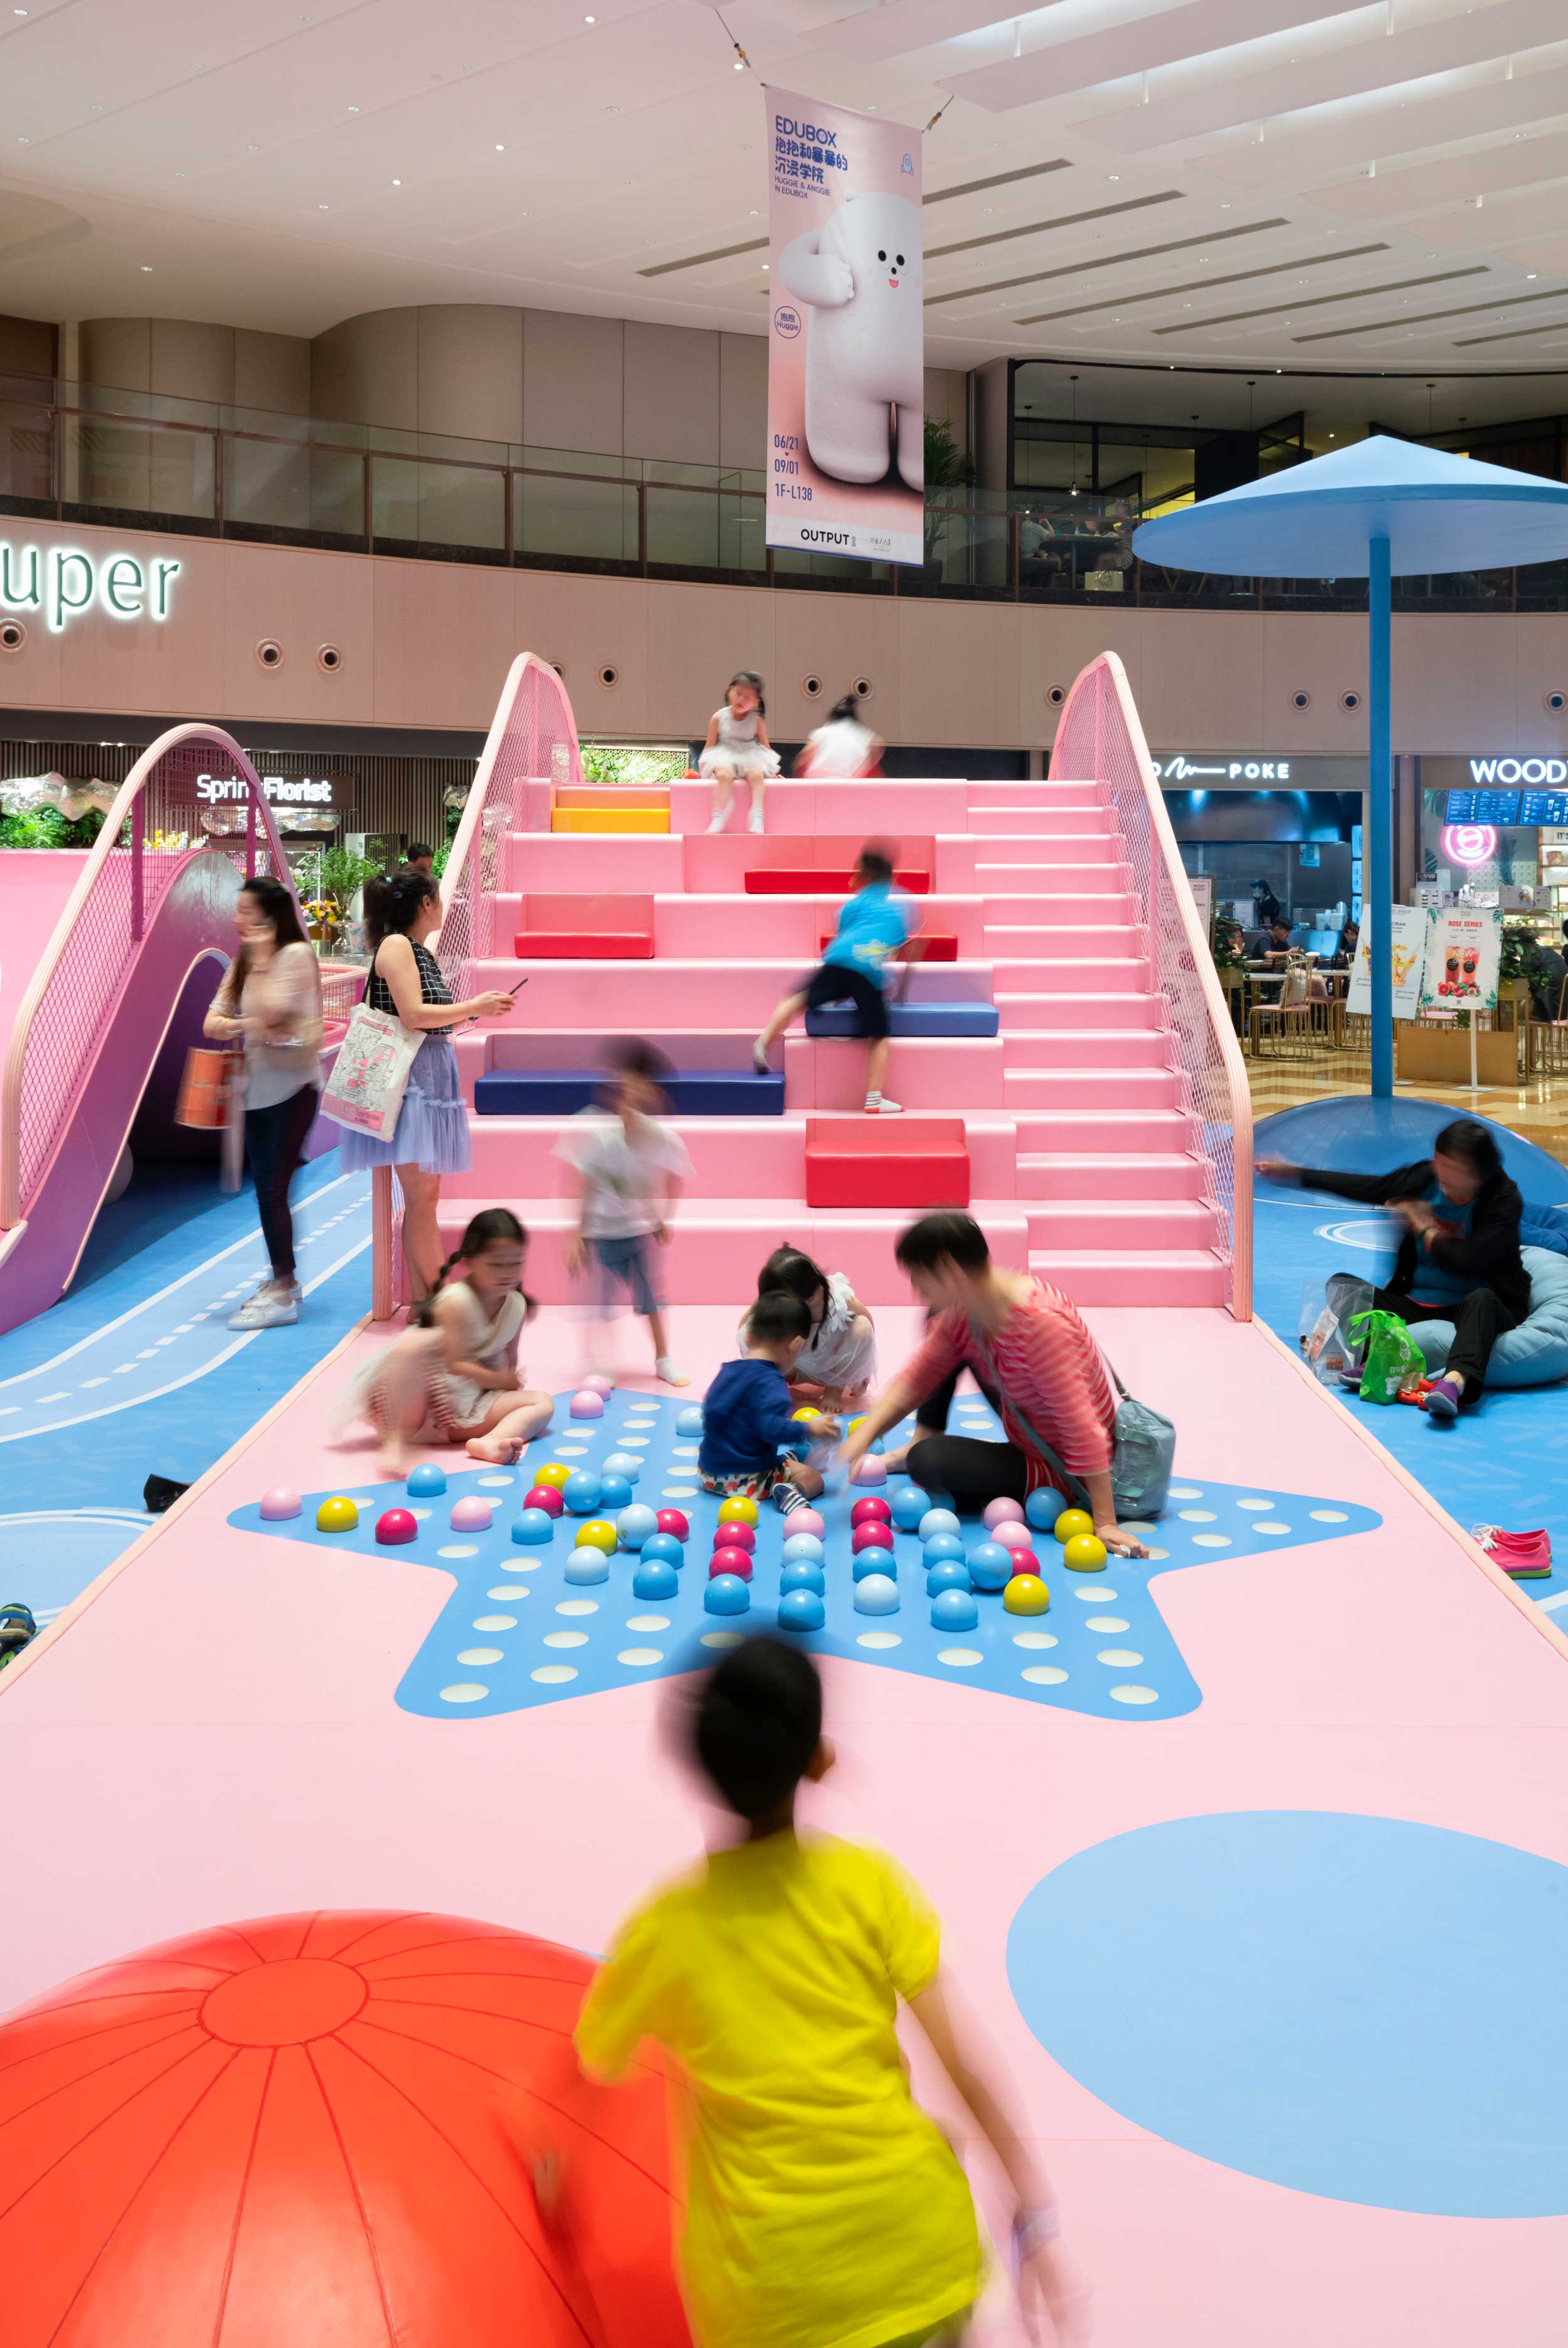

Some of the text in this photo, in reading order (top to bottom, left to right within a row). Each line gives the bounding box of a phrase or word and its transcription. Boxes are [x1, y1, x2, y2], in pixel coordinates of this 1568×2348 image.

[775, 115, 837, 148] EDUBOX
[775, 156, 824, 184] 沉浸学院
[775, 175, 798, 188] HUGGIE
[807, 184, 830, 196] ANGGIE
[775, 184, 808, 199] IN EDUBOX
[777, 320, 798, 331] Huggie
[774, 434, 798, 451] 06/21
[775, 458, 798, 475] 09/01
[775, 483, 812, 501] 1F-L138
[800, 529, 850, 546] OUTPUT
[3, 547, 180, 627] uper
[1230, 763, 1290, 779] POKE
[1470, 758, 1568, 783] WOOD
[196, 775, 332, 804] Sprin Florist
[1453, 949, 1474, 958] NEW
